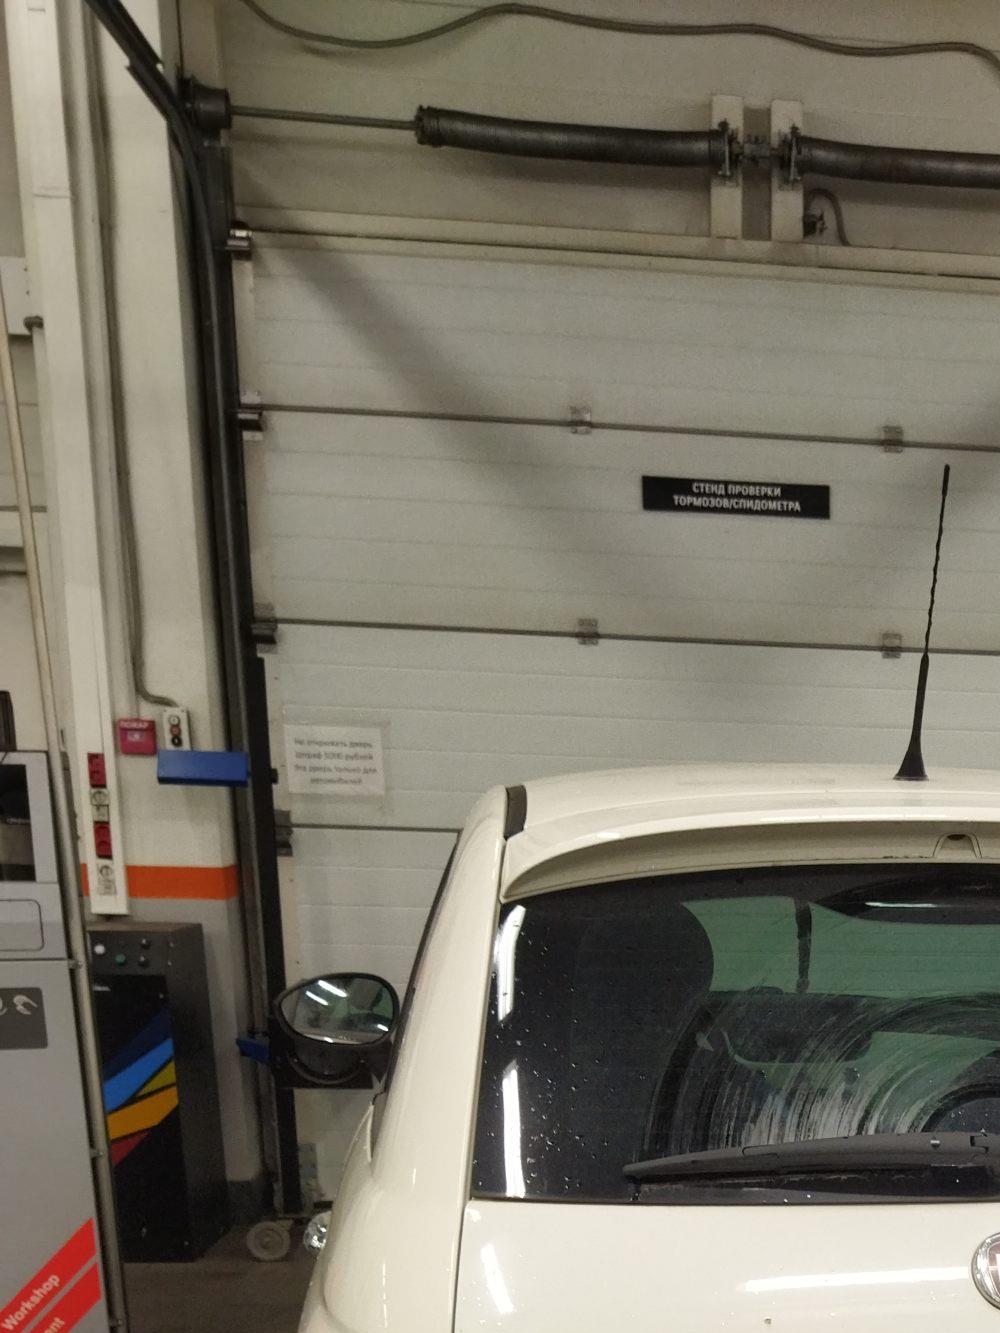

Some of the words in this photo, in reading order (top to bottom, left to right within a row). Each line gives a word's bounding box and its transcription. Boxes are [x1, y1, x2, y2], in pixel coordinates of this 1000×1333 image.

[692, 482, 725, 496] СТЕНД
[727, 484, 782, 497] ПРОВЕРКИ
[672, 494, 801, 512] ТОРМОЗОВ/СПИДОМЕТРА
[2, 1273, 61, 1332] Workshop
